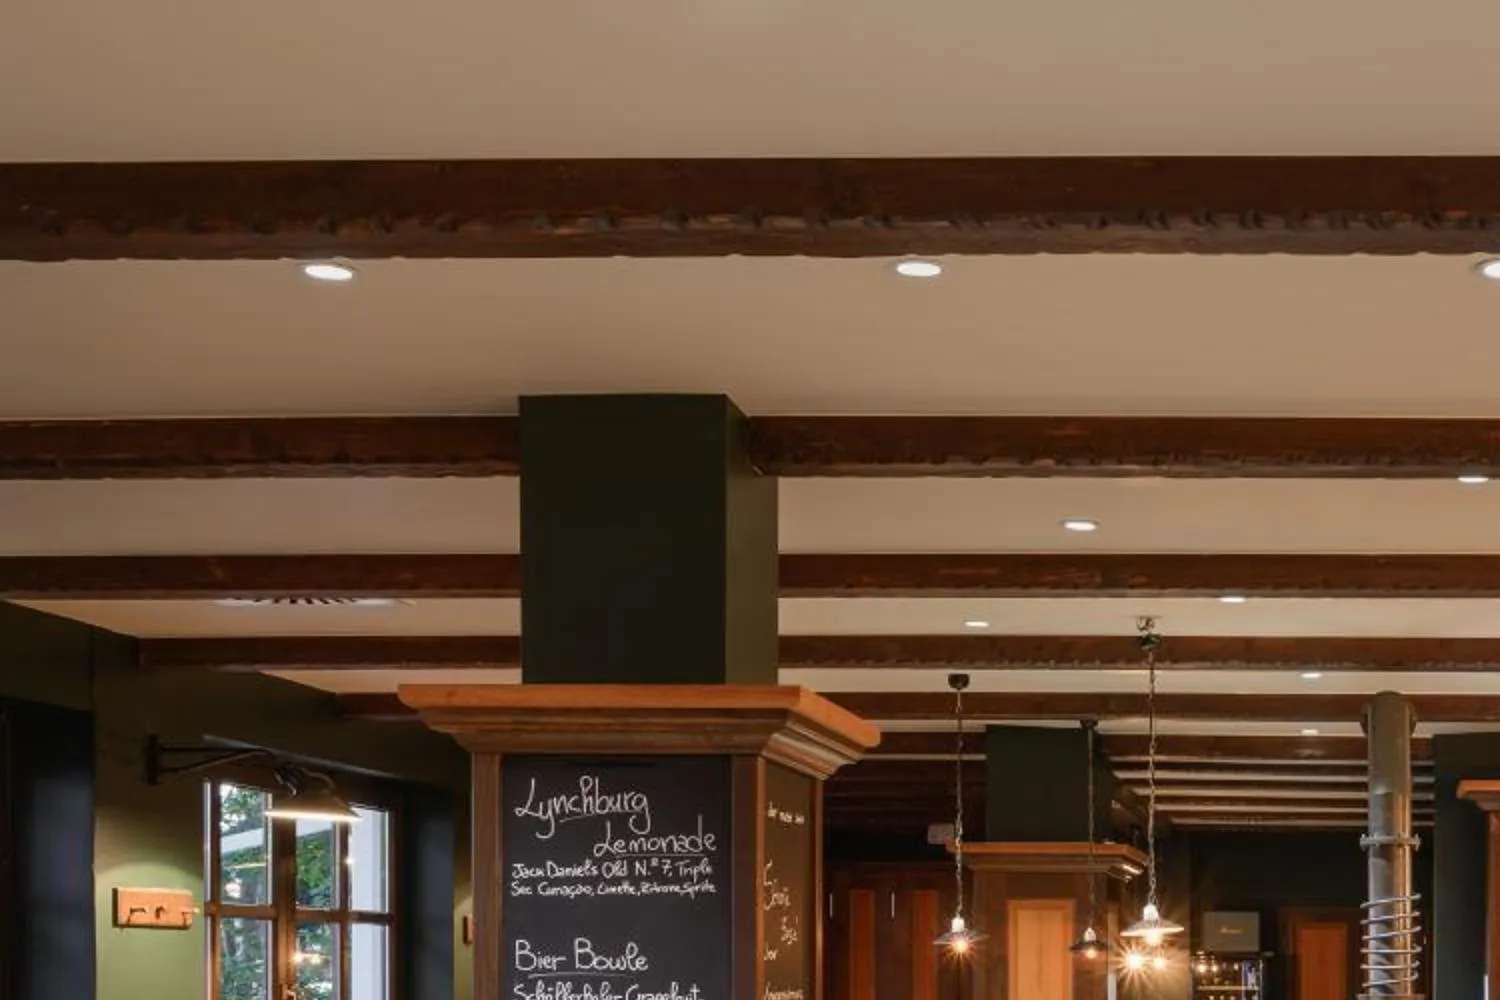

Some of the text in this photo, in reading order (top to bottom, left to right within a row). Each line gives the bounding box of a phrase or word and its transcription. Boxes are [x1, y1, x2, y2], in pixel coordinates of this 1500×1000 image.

[514, 775, 650, 839] Lynchburg
[594, 815, 717, 857] Lemonade
[602, 859, 628, 879] Old
[674, 857, 714, 884] Triple
[514, 938, 648, 971] Bier Bowle
